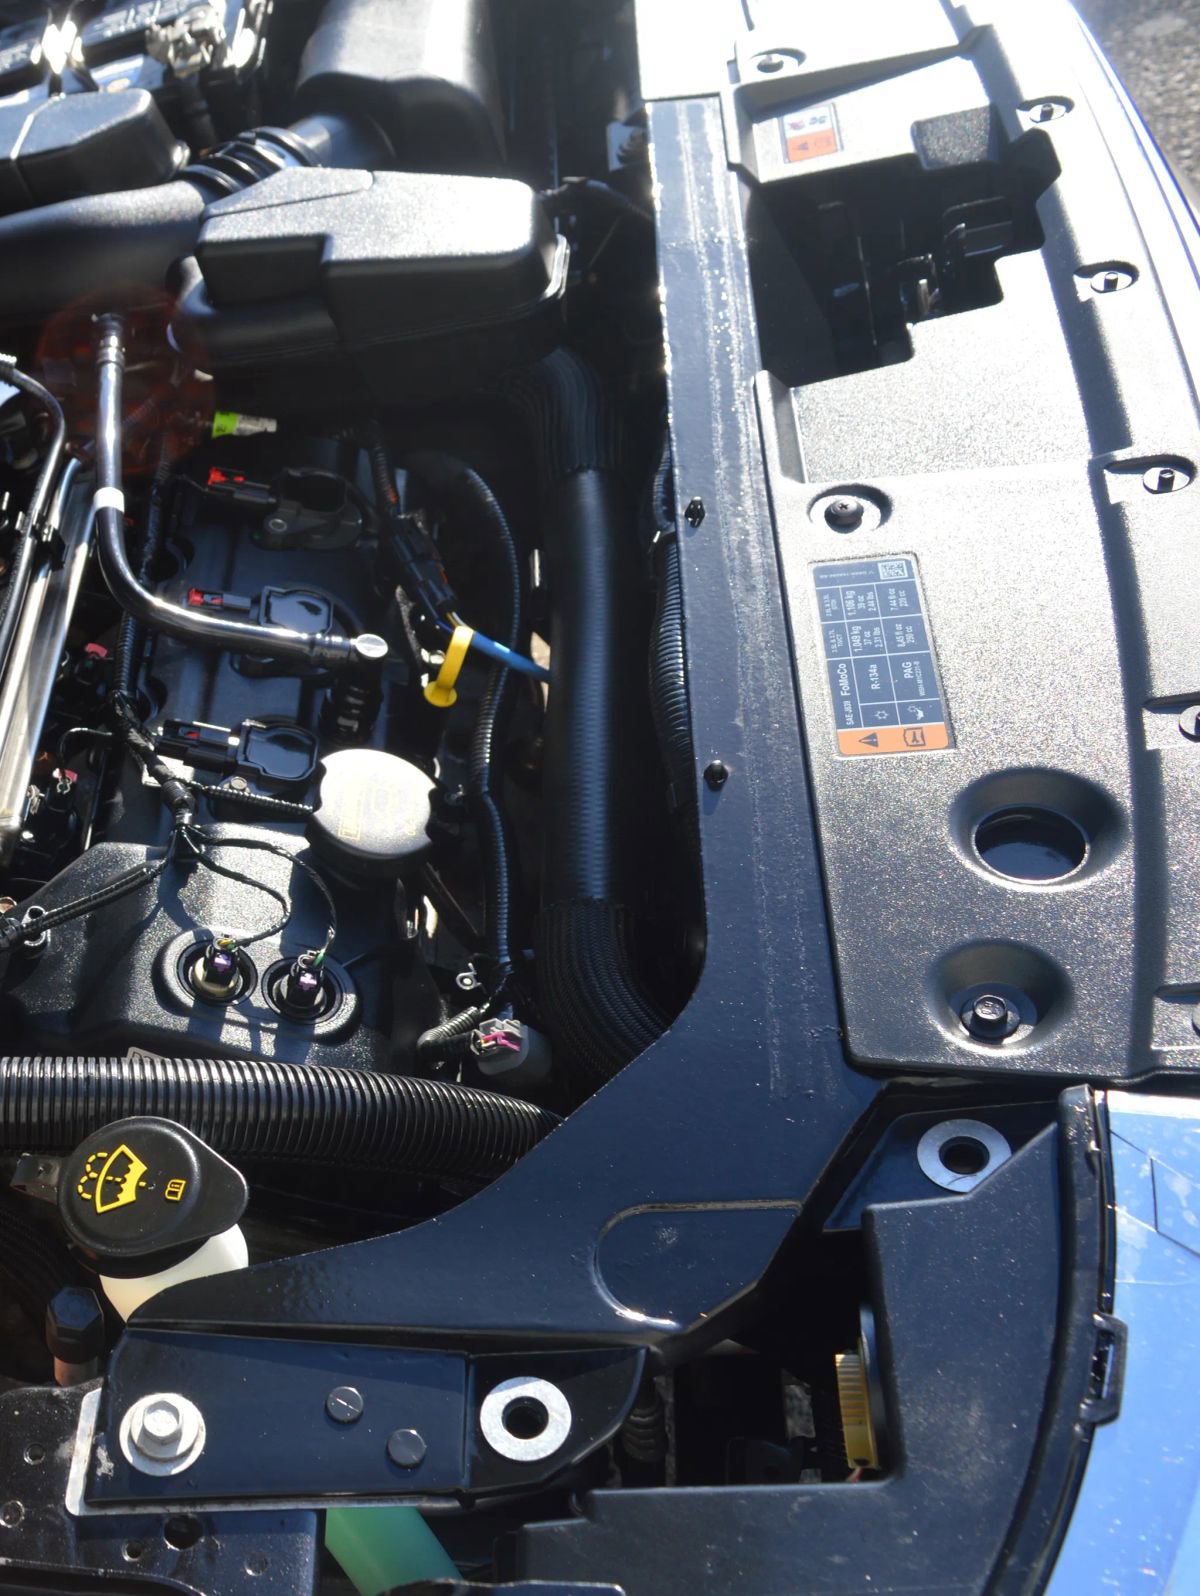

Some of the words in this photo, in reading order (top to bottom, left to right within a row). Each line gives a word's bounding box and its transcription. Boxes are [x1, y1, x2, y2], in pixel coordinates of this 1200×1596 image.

[844, 591, 856, 599] kg
[867, 601, 876, 611] 2.44
[850, 626, 862, 634] kg
[851, 636, 863, 652] 1.049
[868, 664, 880, 689] R-134a
[902, 662, 914, 678] PAG
[837, 664, 851, 696] FoMoCo
